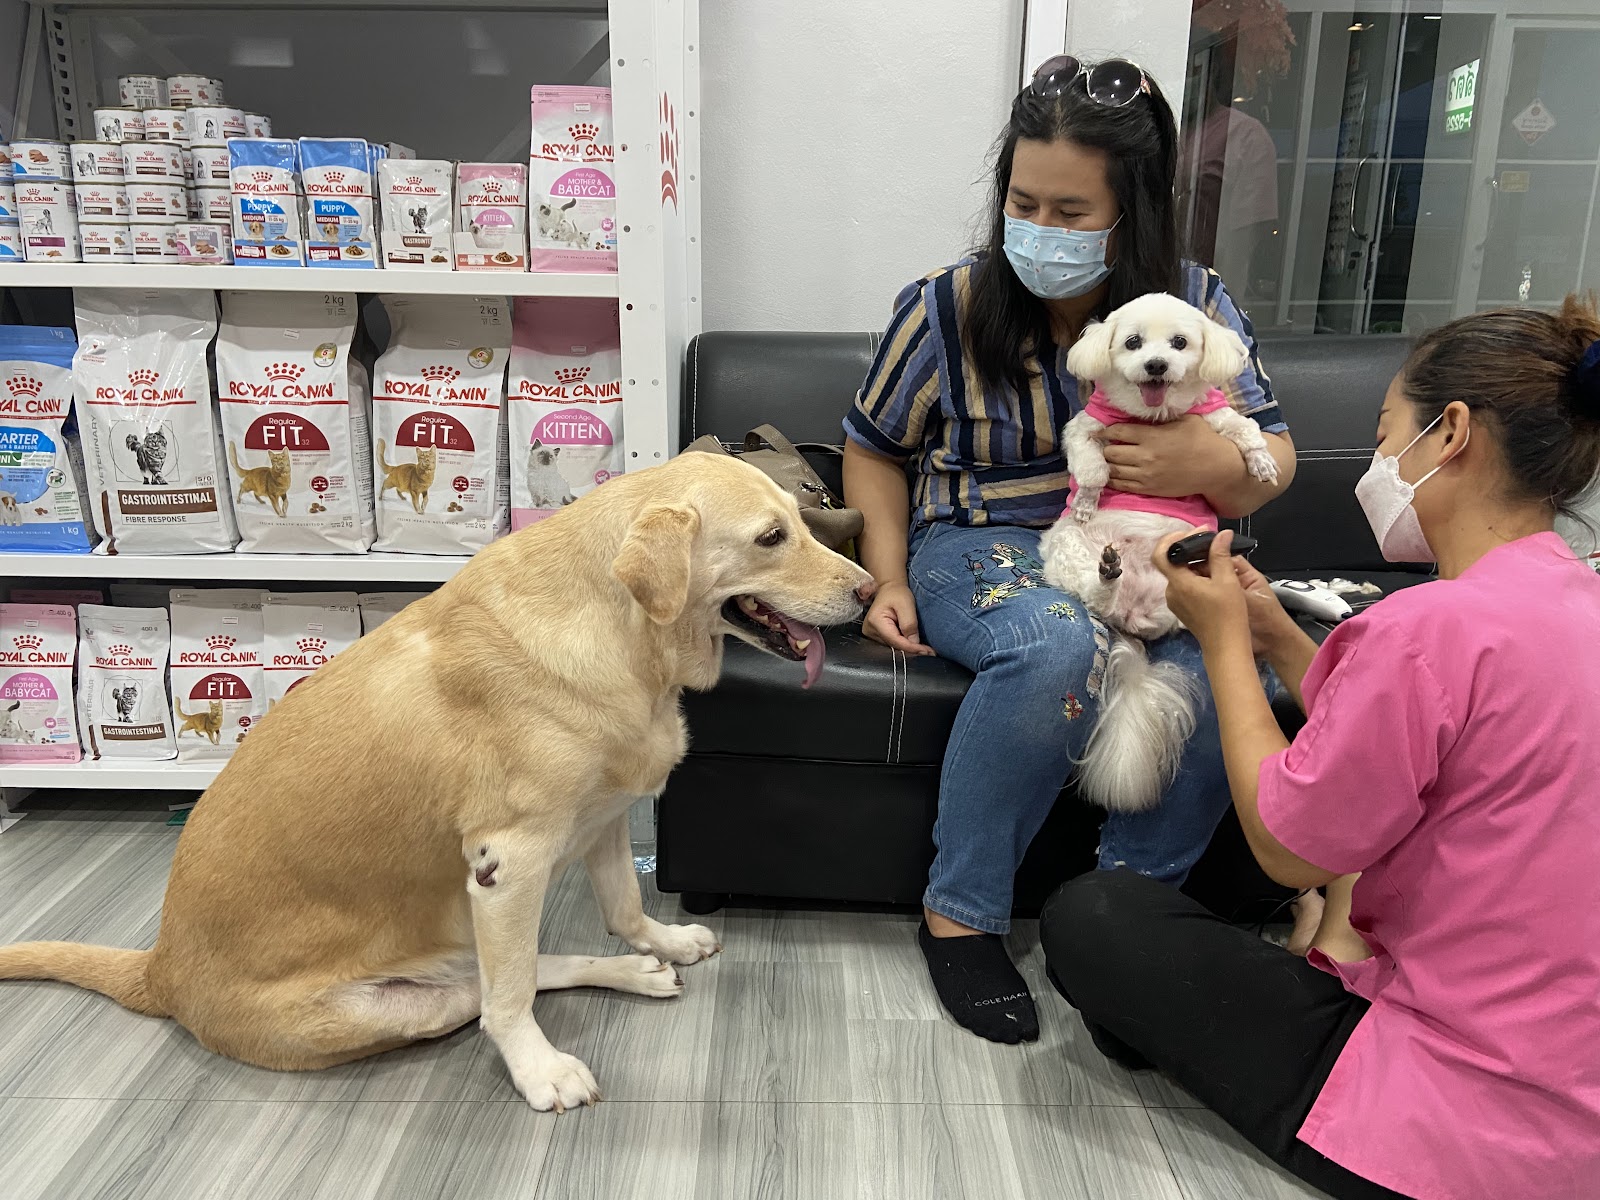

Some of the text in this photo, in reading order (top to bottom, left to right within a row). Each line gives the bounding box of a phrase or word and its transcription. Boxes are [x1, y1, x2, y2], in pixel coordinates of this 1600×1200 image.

[543, 144, 614, 157] ROYAL CANI
[235, 183, 259, 191] ROYAL
[308, 184, 363, 193] ROYAL CANIN
[558, 185, 610, 196] BABYCAT
[324, 295, 344, 305] 2 kg
[480, 306, 498, 316] 2 kg
[55, 330, 64, 339] kg
[96, 387, 138, 400] ROYAL
[229, 381, 333, 399] ROYAL CANIN
[385, 380, 487, 400] ROYAL CANIN
[520, 380, 620, 398] ROYAL CANIN
[0, 399, 21, 412] YAL
[422, 416, 446, 424] Regular
[414, 423, 453, 444] FIT
[543, 422, 602, 438] KITTEN
[0, 433, 39, 444] ARTER
[263, 426, 303, 445] FIT
[91, 415, 104, 486] VETERINARY
[122, 492, 212, 505] GASTROINTESTINAL
[68, 527, 78, 535] kg
[0, 652, 67, 662] OYAL CANIN
[96, 657, 118, 665] ROYAL
[180, 652, 256, 662] ROYAL CANIN
[274, 655, 309, 665] ROYAL
[5, 688, 51, 698] BABYCAT
[208, 682, 236, 696] FIT
[104, 726, 162, 735] GASTROINTESTINAL
[974, 998, 1001, 1006] COLE
